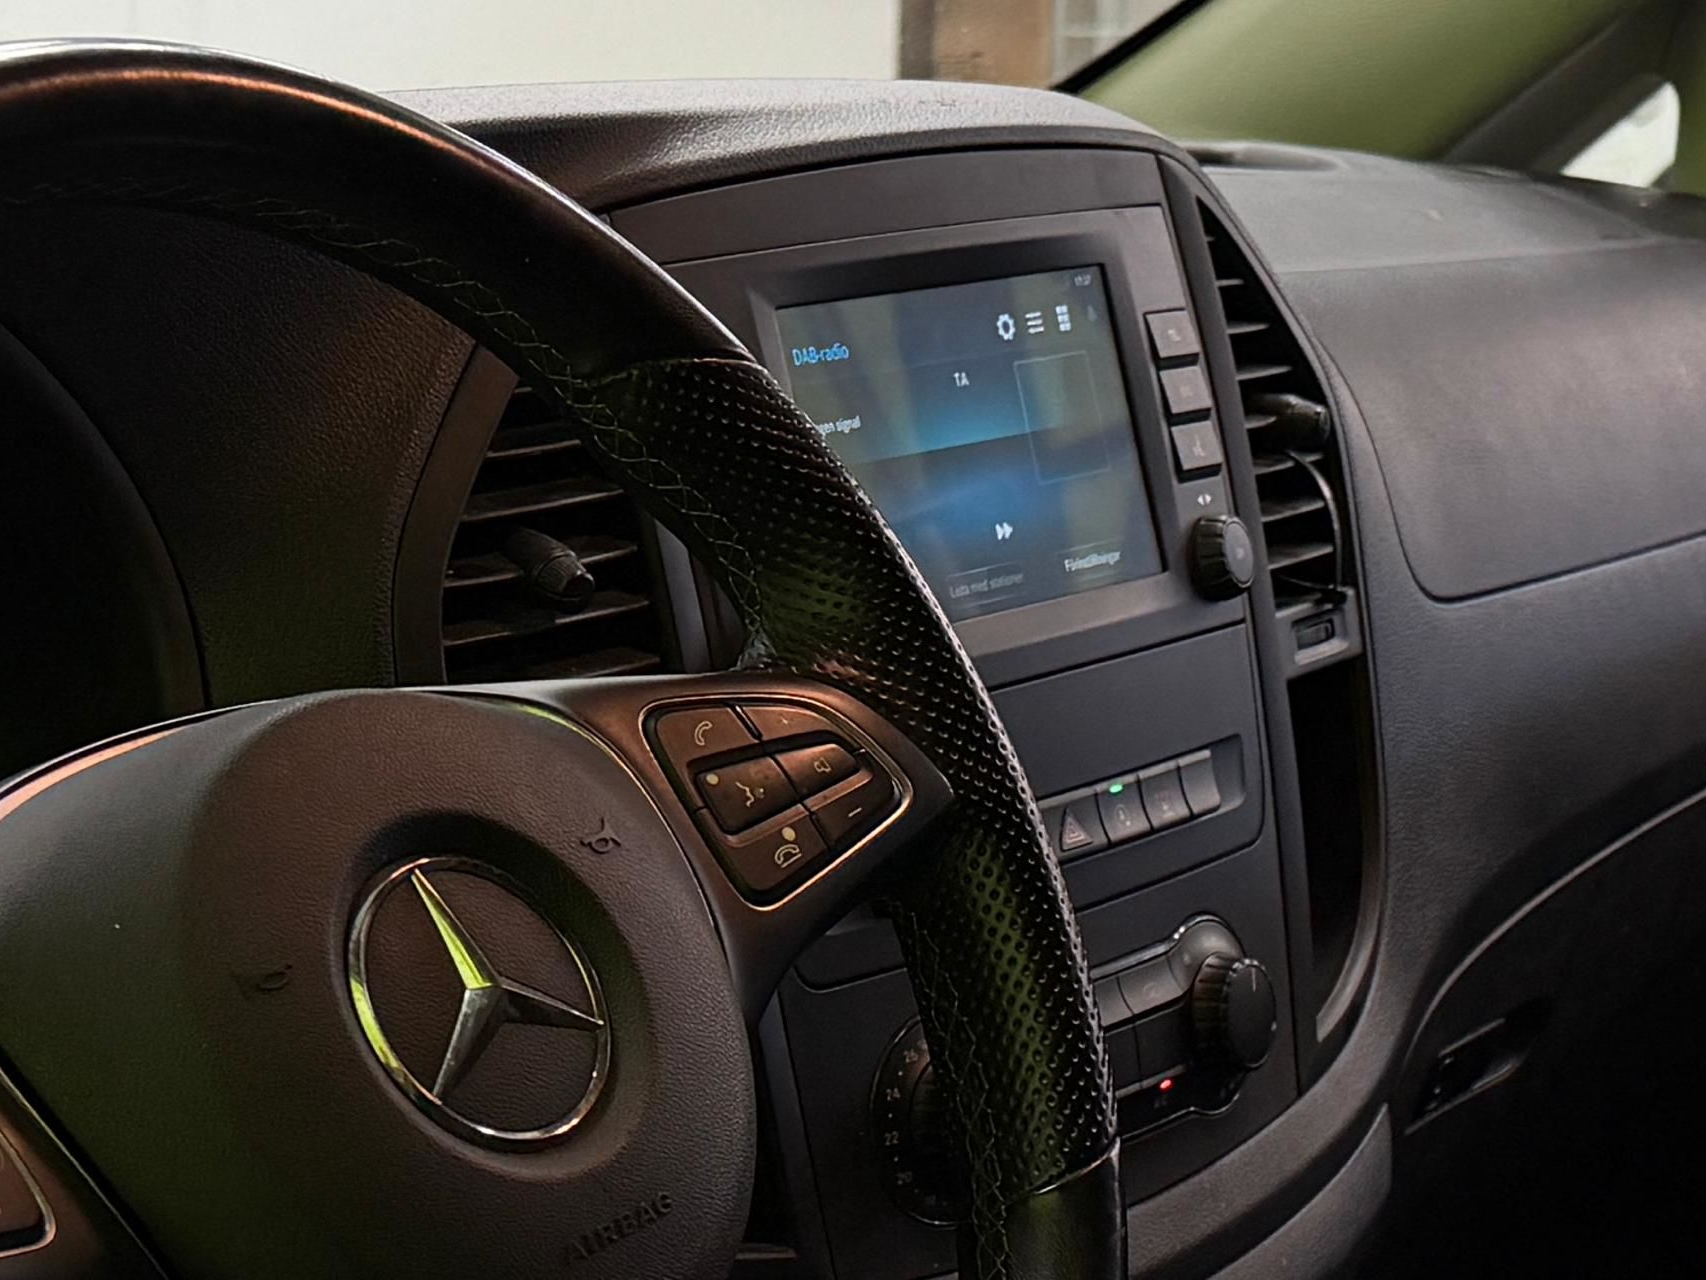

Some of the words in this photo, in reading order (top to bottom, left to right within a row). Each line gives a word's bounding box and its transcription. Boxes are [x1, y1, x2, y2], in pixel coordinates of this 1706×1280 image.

[792, 343, 849, 366] DAB-radio
[953, 372, 970, 387] TA
[836, 416, 861, 434] signal
[885, 1088, 901, 1102] 24
[884, 1132, 900, 1146] 22
[566, 1192, 675, 1265] AIRBAG
